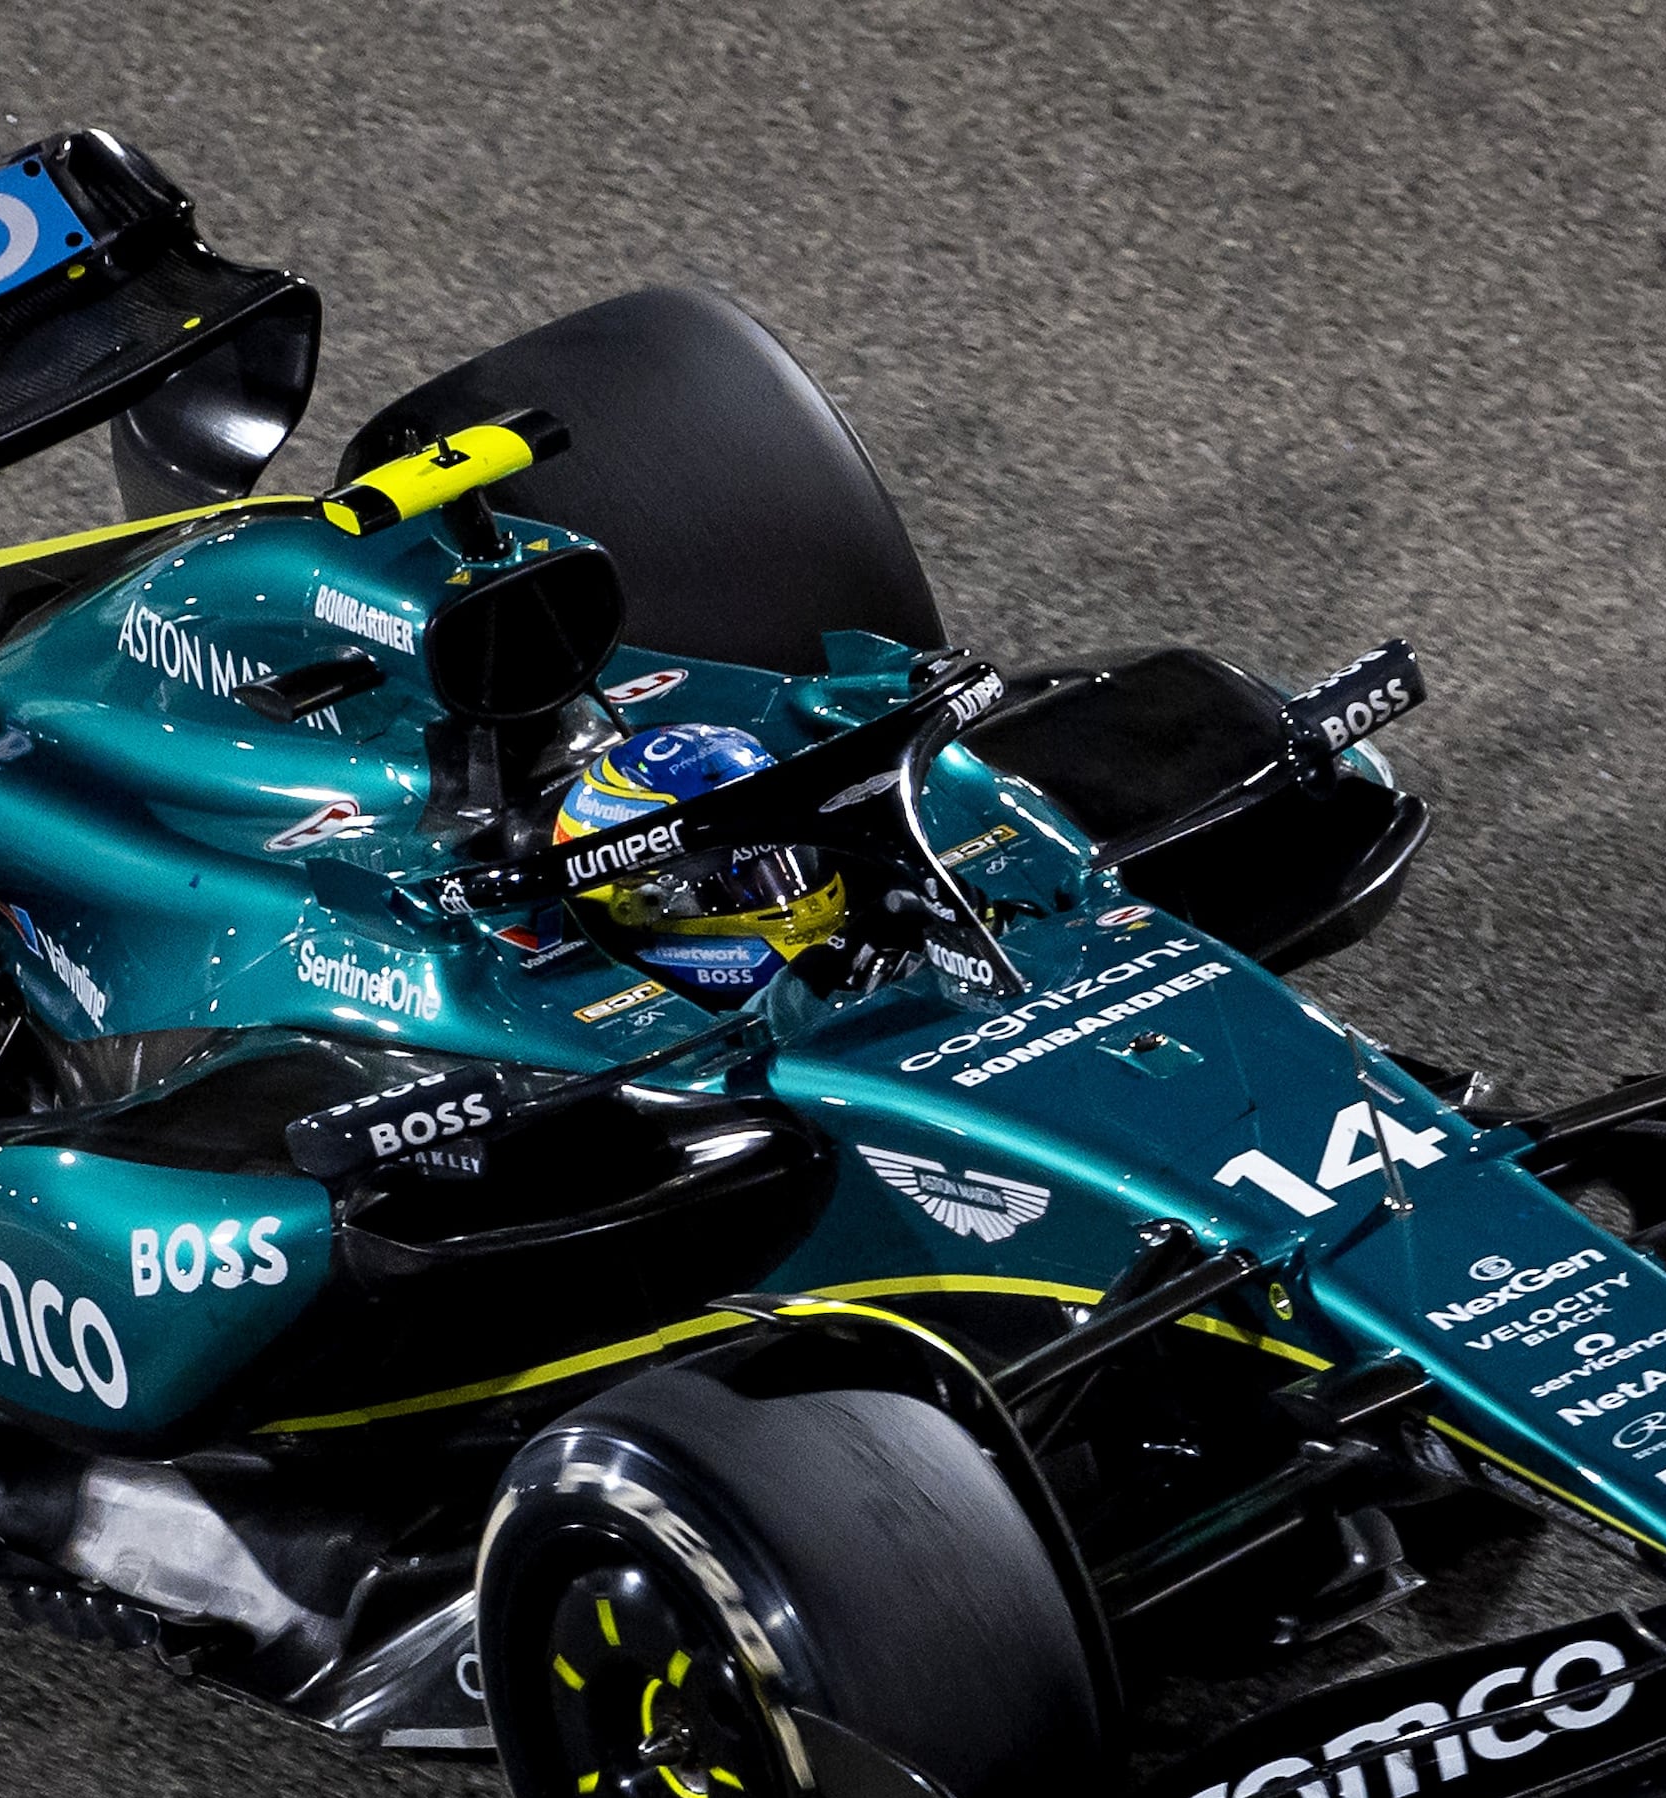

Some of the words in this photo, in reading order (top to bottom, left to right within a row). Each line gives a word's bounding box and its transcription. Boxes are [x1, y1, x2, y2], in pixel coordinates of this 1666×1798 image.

[118, 600, 204, 690] ASTON
[314, 584, 415, 656] BOMBARDIER
[1320, 678, 1410, 751] BOSS
[297, 939, 442, 1021] SentinelOne
[697, 968, 754, 984] BOSS
[899, 937, 1200, 1073] cognizant
[951, 961, 1232, 1087] BOMBARDIER
[368, 1093, 492, 1158] BOSS
[1213, 1101, 1448, 1218] 14
[132, 1216, 289, 1297] BOSS
[1425, 1248, 1607, 1331] NexGen
[1464, 1271, 1630, 1350] VELOCITY
[1521, 1303, 1613, 1347] BLACK
